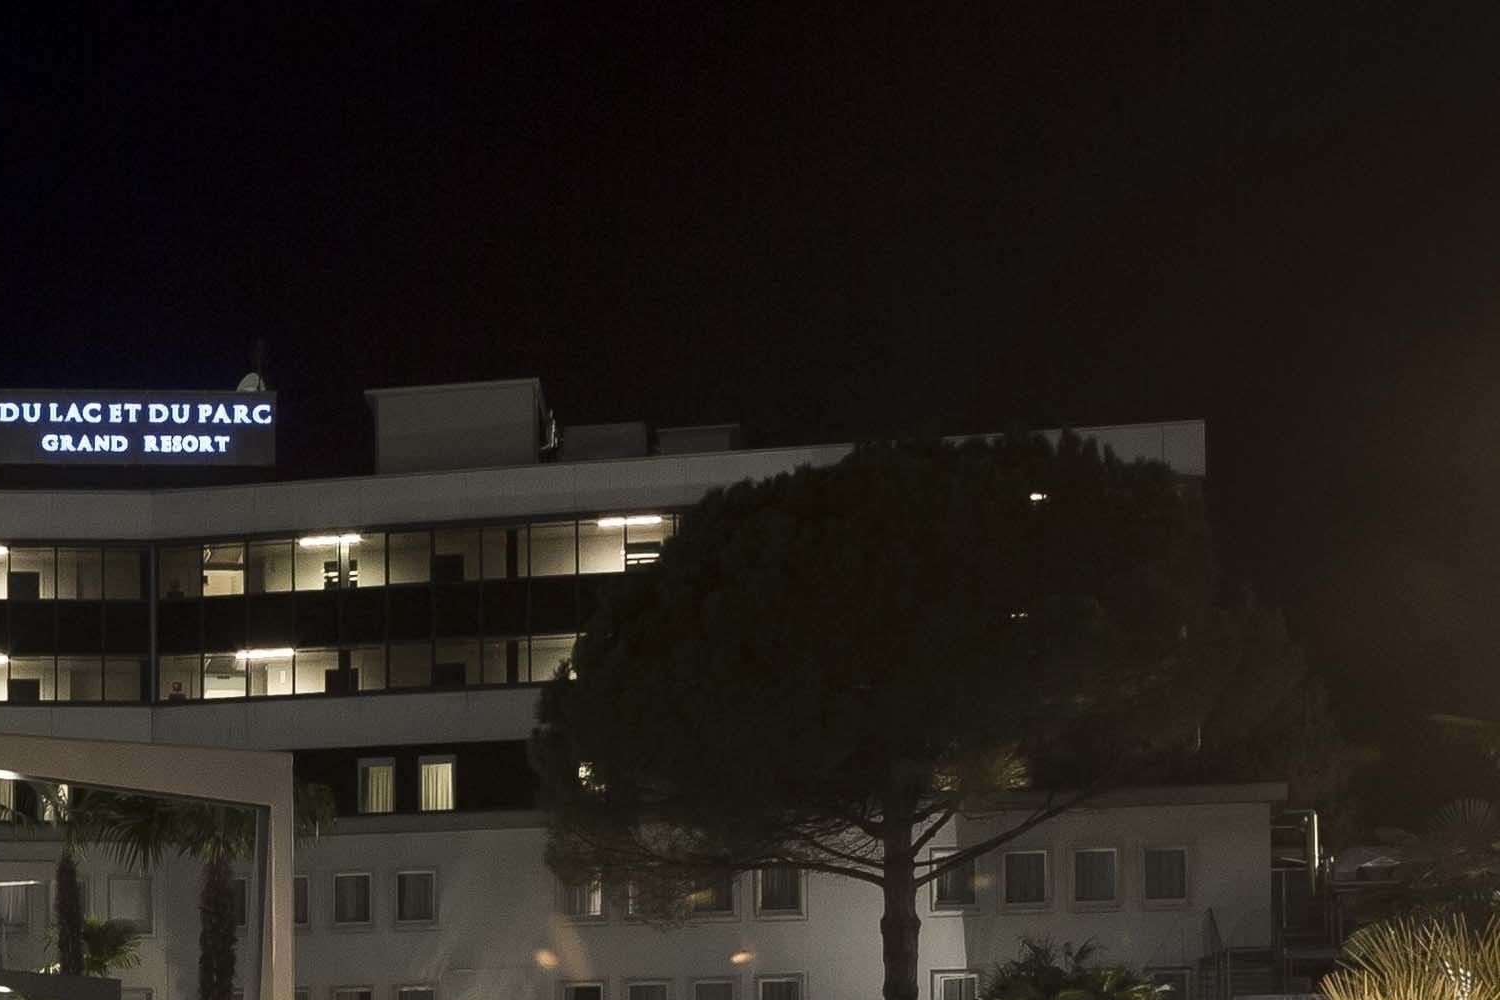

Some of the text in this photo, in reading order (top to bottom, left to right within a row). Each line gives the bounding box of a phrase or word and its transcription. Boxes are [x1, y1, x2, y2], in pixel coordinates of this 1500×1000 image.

[48, 402, 102, 423] LAC
[108, 403, 142, 424] ET
[148, 403, 191, 424] DU
[197, 404, 272, 425] PARC
[41, 433, 231, 453] GRAND RESORT
